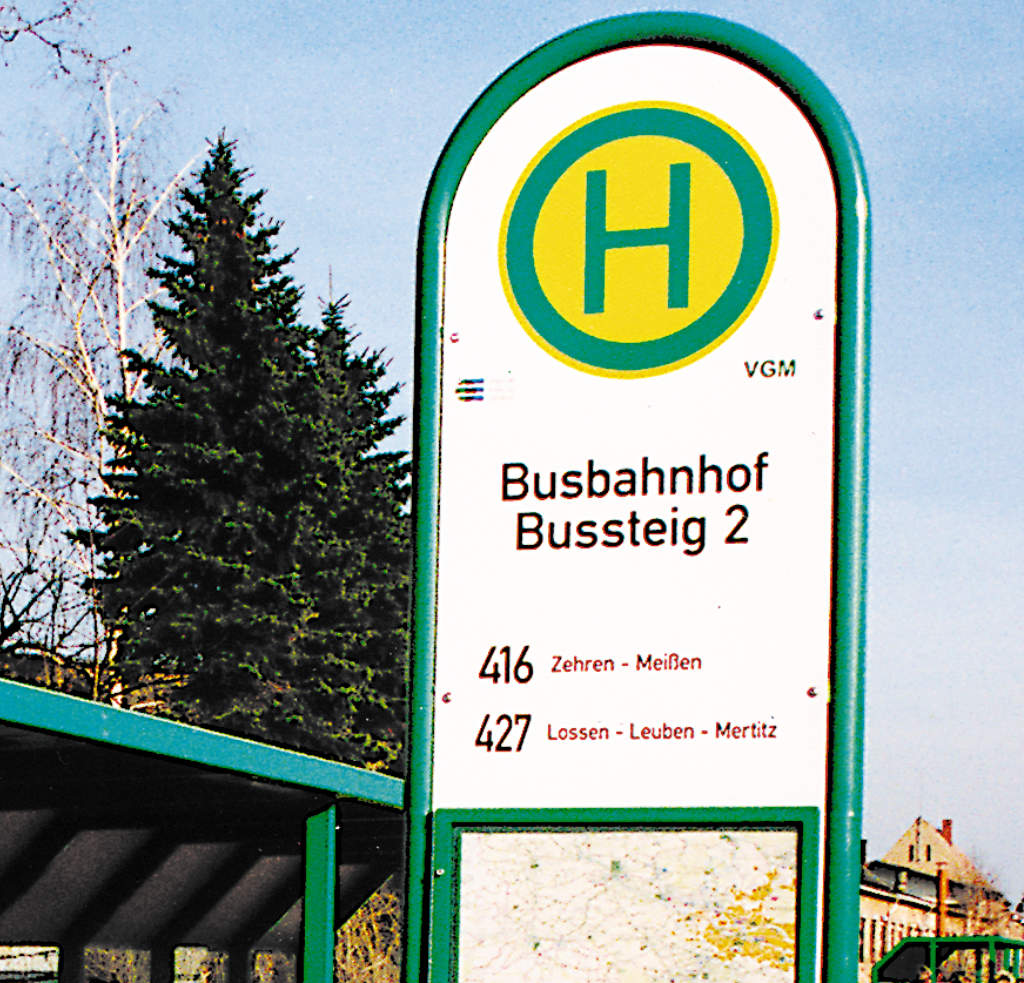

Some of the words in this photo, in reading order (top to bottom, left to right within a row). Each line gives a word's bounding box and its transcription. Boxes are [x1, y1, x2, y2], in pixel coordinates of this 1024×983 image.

[583, 162, 691, 314] H
[744, 359, 796, 378] VGM
[502, 451, 769, 502] Busbahnhof
[516, 506, 707, 557] Bussteig
[724, 503, 749, 545] 2
[479, 645, 534, 684] 416
[551, 654, 615, 673] Zehren
[636, 653, 702, 672] Meißen
[475, 714, 532, 753] 427
[547, 723, 610, 741] Lossen
[629, 722, 694, 741] Leuben
[715, 721, 777, 740] Mertitz
